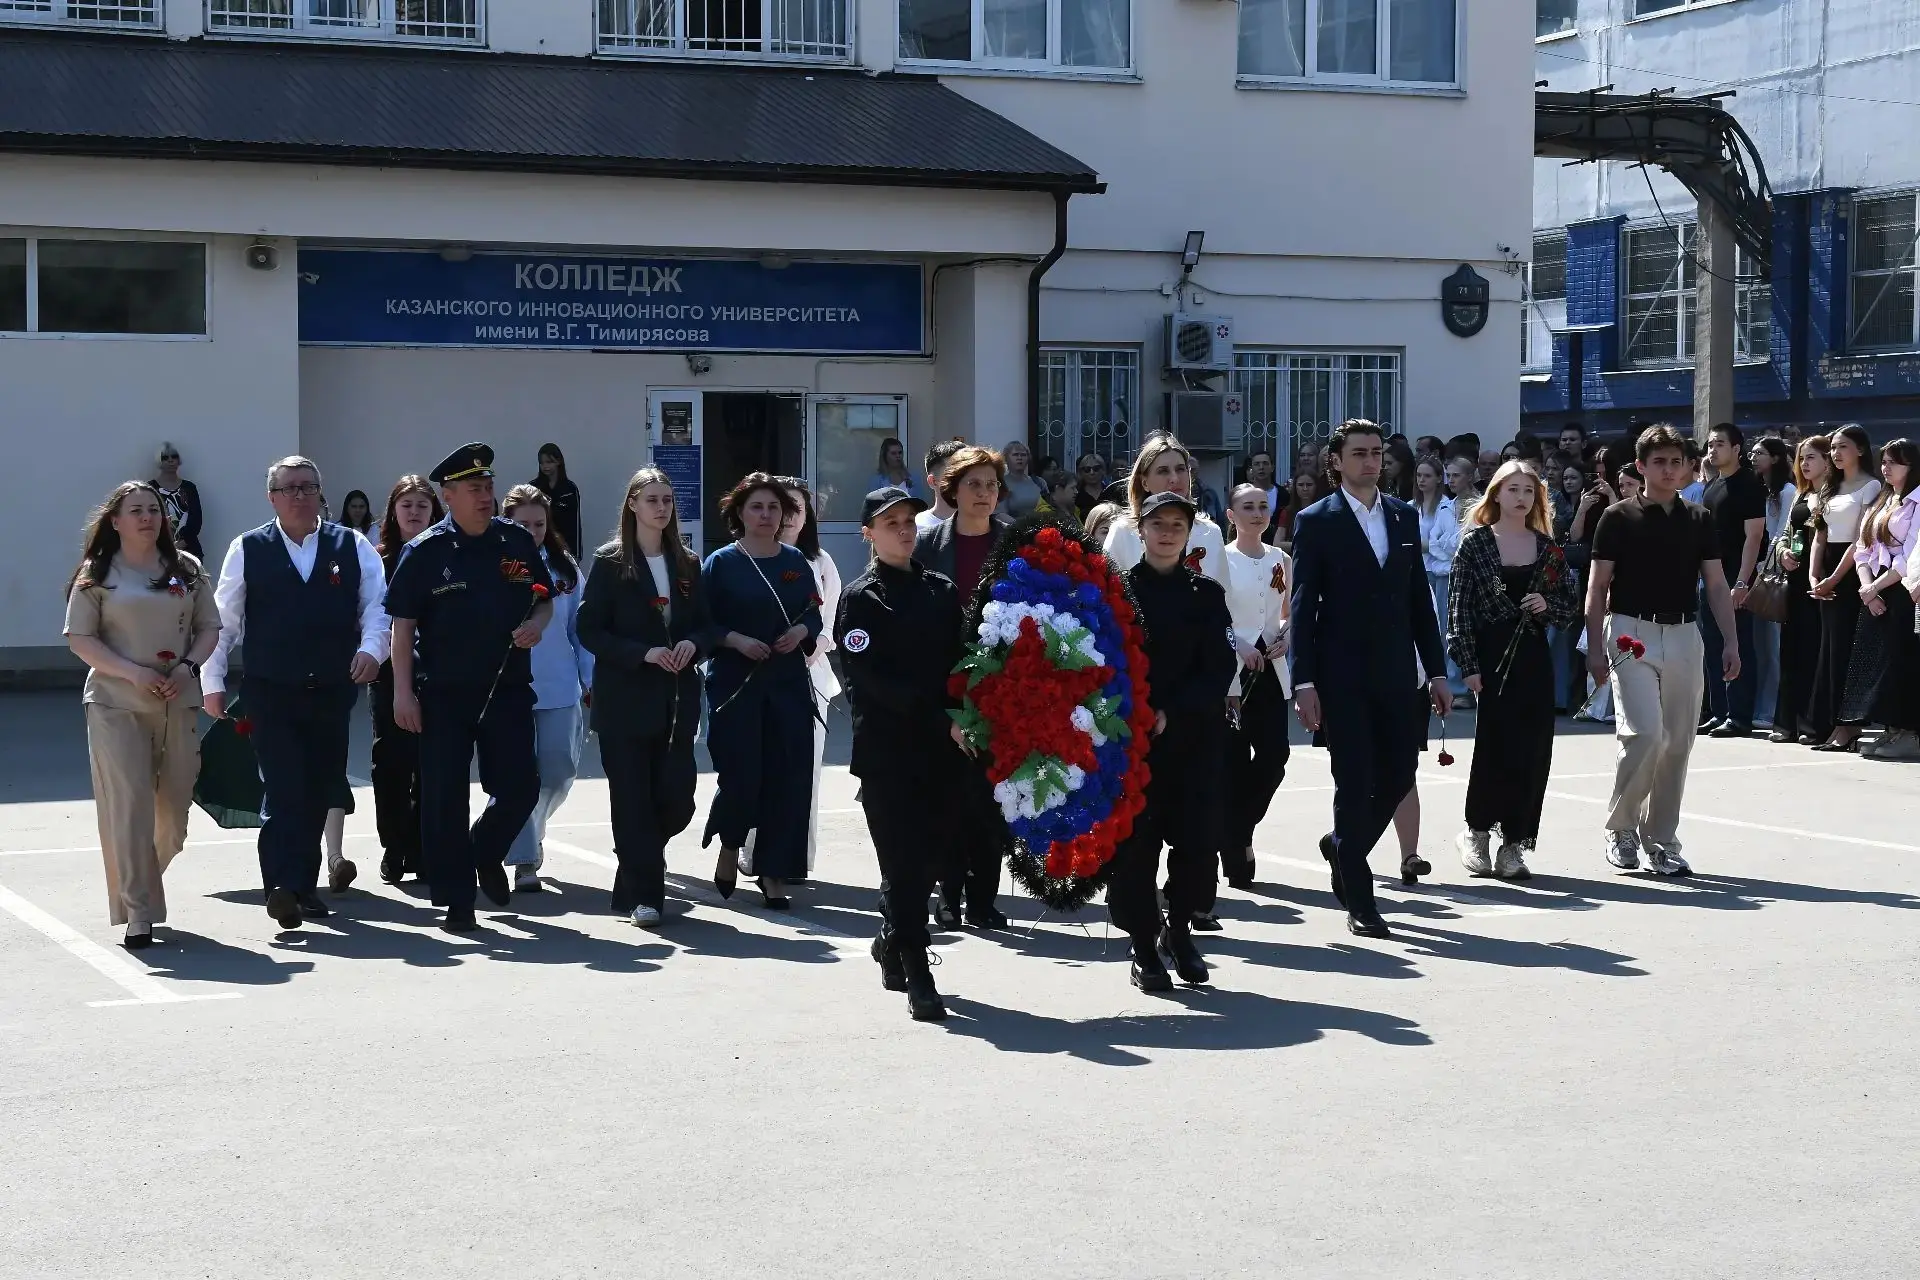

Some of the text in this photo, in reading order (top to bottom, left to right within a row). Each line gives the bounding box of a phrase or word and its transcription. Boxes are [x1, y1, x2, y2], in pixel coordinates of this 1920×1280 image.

[515, 263, 683, 296] КОЛЛЕДЖ
[386, 299, 861, 322] КАЗАНСКОГО ИННОВАЦИОННОГО УНИВЕРСИТЕТА
[475, 323, 710, 344] имени В.Г. Тимирясова
